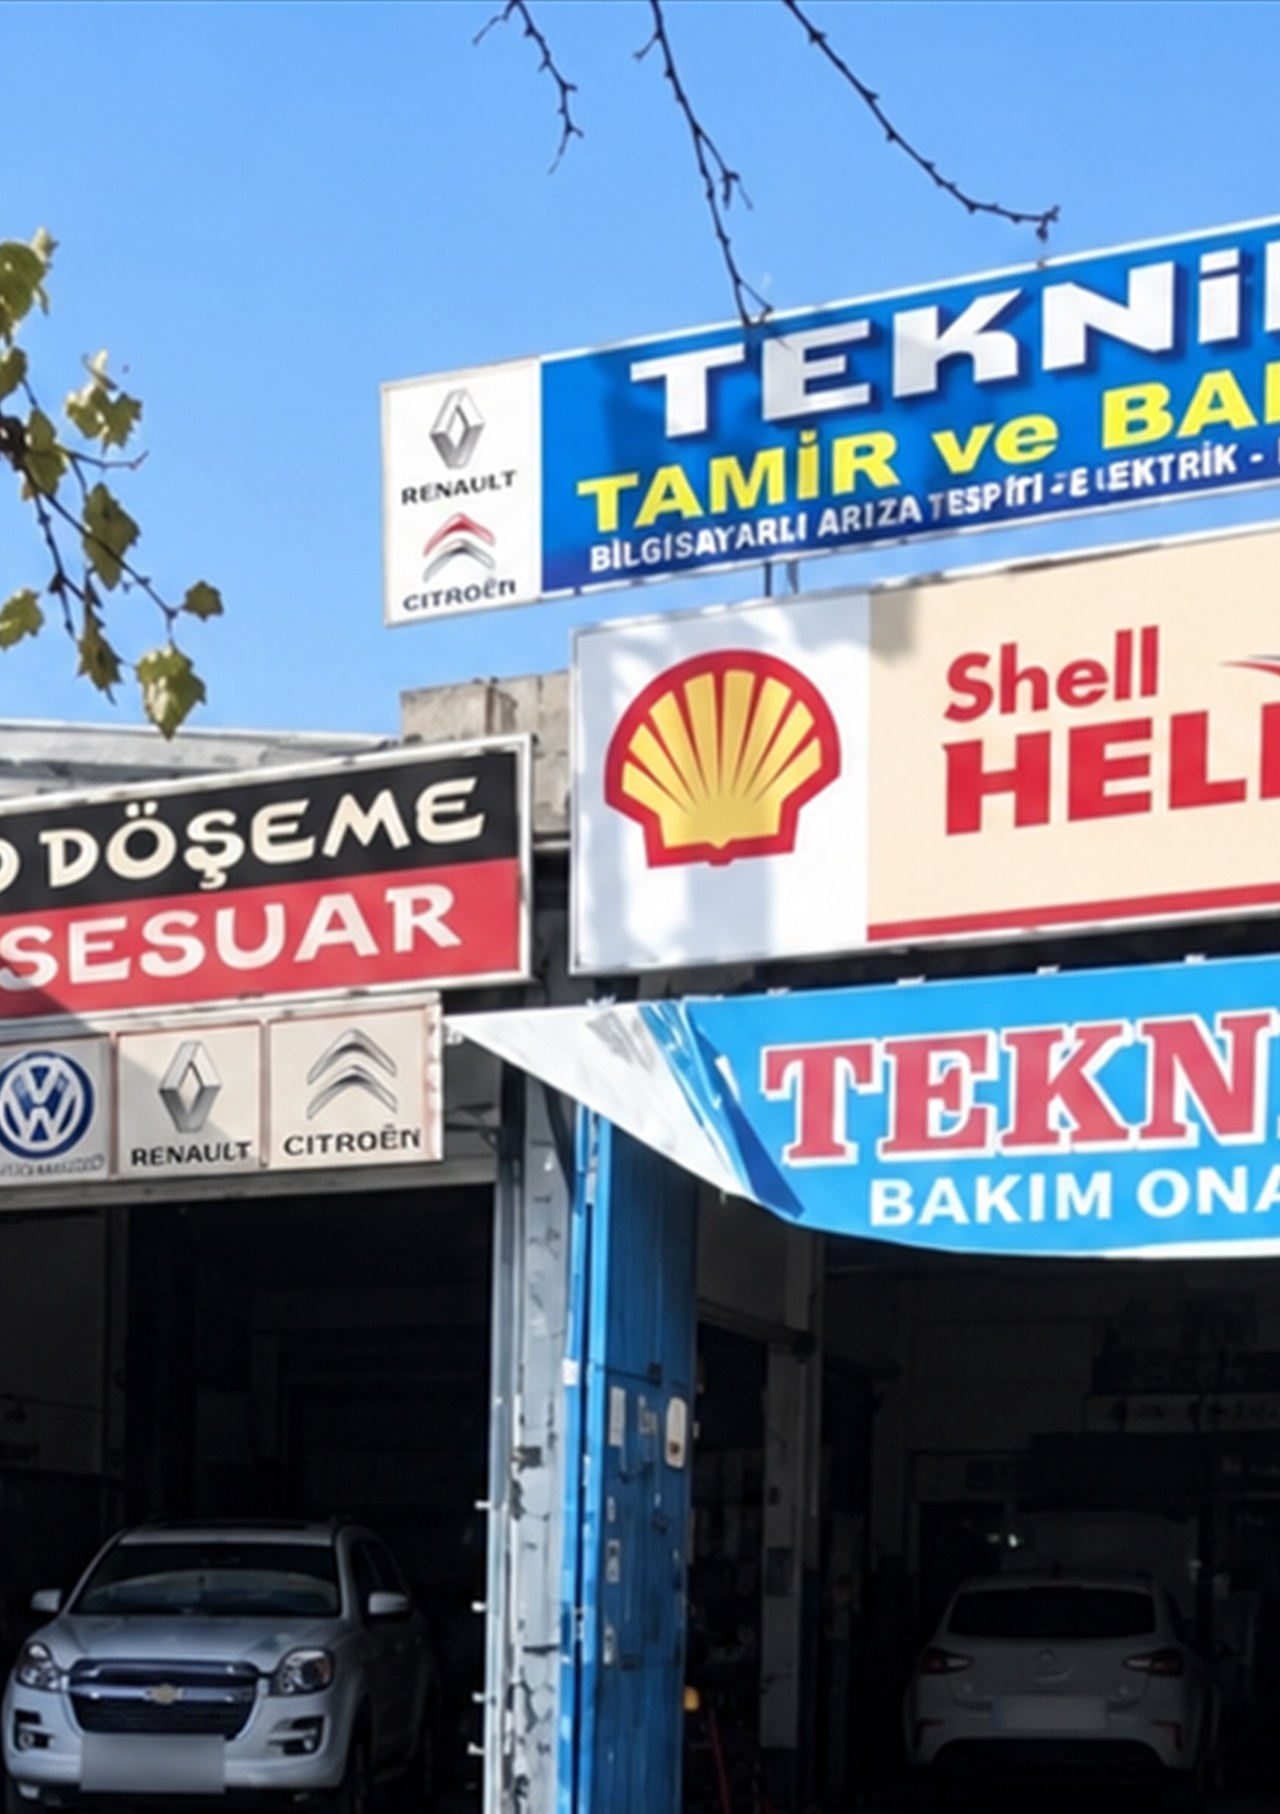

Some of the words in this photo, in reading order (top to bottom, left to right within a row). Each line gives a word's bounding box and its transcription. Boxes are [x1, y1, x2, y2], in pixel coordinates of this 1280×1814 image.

[401, 470, 517, 506] RENAULT
[578, 429, 901, 534] TAMİR
[931, 413, 1059, 474] ve
[942, 624, 1161, 725] Shell
[39, 777, 486, 891] DÖŞEME
[131, 1141, 253, 1167] RENAULT
[284, 1123, 421, 1157] CITROËN
[867, 1169, 1114, 1229] BAKIM
